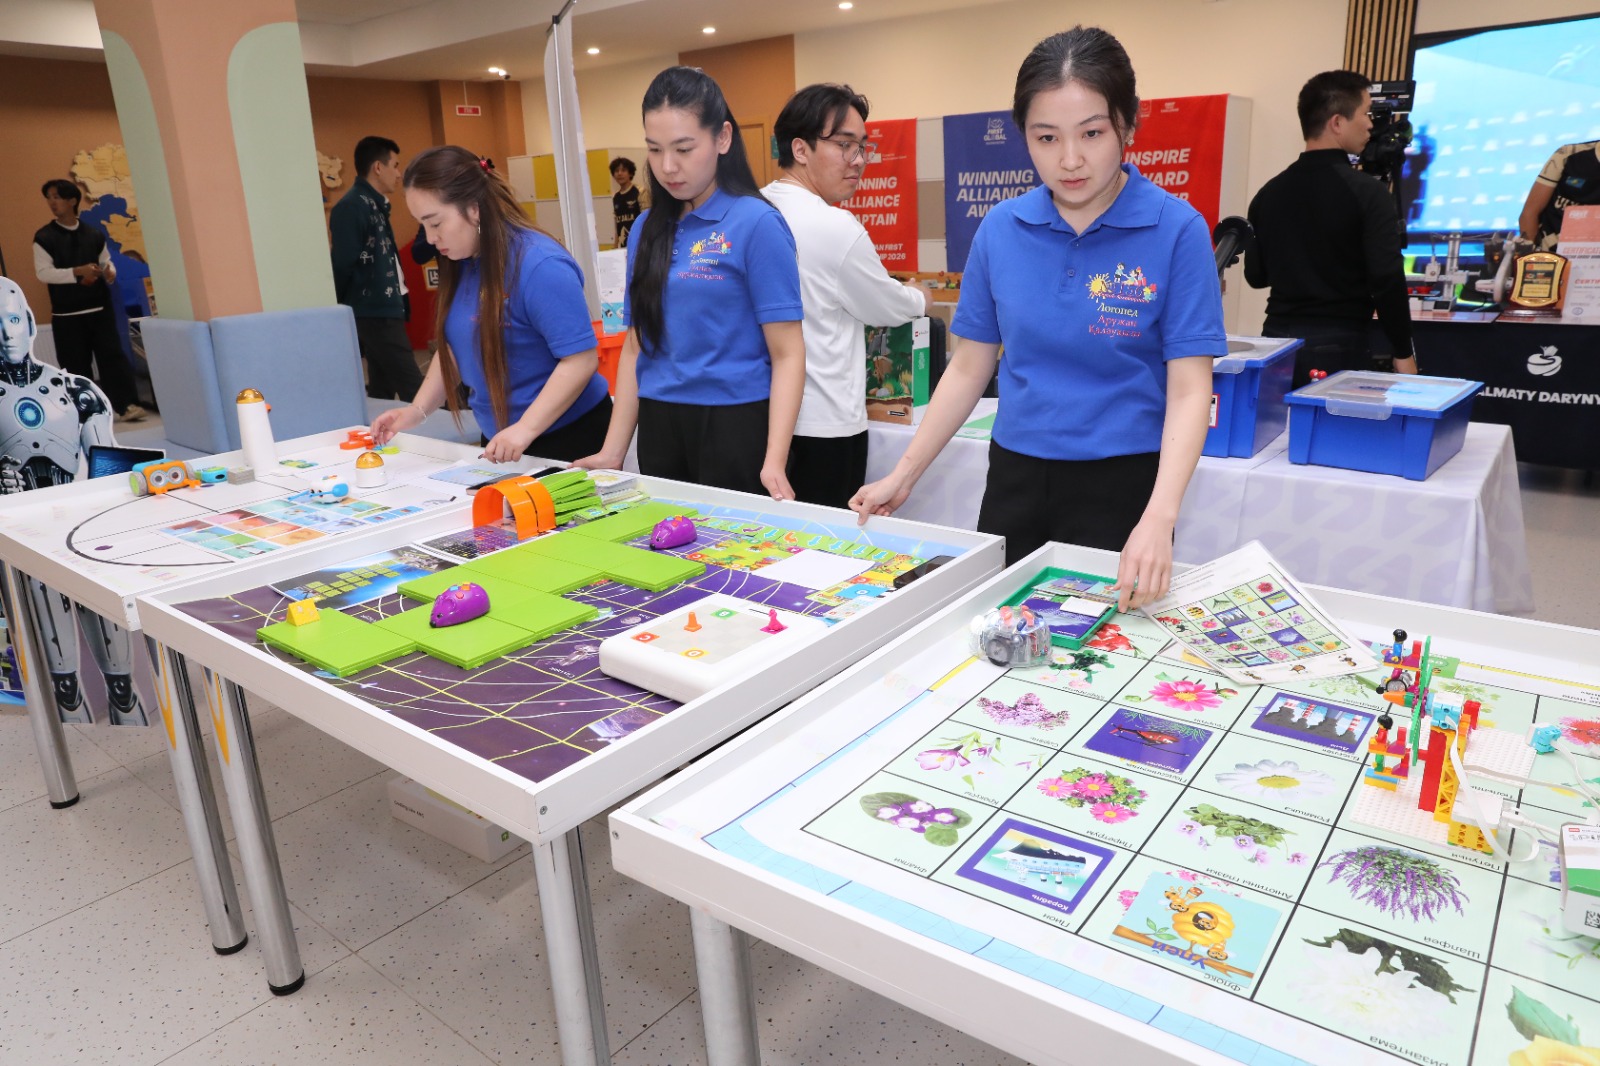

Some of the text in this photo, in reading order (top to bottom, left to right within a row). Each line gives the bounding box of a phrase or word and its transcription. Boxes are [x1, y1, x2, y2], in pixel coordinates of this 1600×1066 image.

[1124, 148, 1191, 166] INSPIRE
[856, 176, 898, 190] NNING
[958, 169, 1034, 186] WINNING
[1142, 170, 1190, 187] ARD
[854, 213, 898, 226] APTAIN
[887, 252, 907, 260] 2026
[1097, 302, 1138, 318] Логопед
[893, 857, 927, 874] Фиалки
[1206, 867, 1294, 900] Анютины глазки
[1031, 893, 1069, 911] Корабль
[1043, 912, 1071, 928] Пион
[1152, 940, 1206, 970] Улей
[1423, 935, 1481, 960] Шалфей
[1204, 972, 1241, 993] Флокс
[1369, 1035, 1449, 1066] изантема
